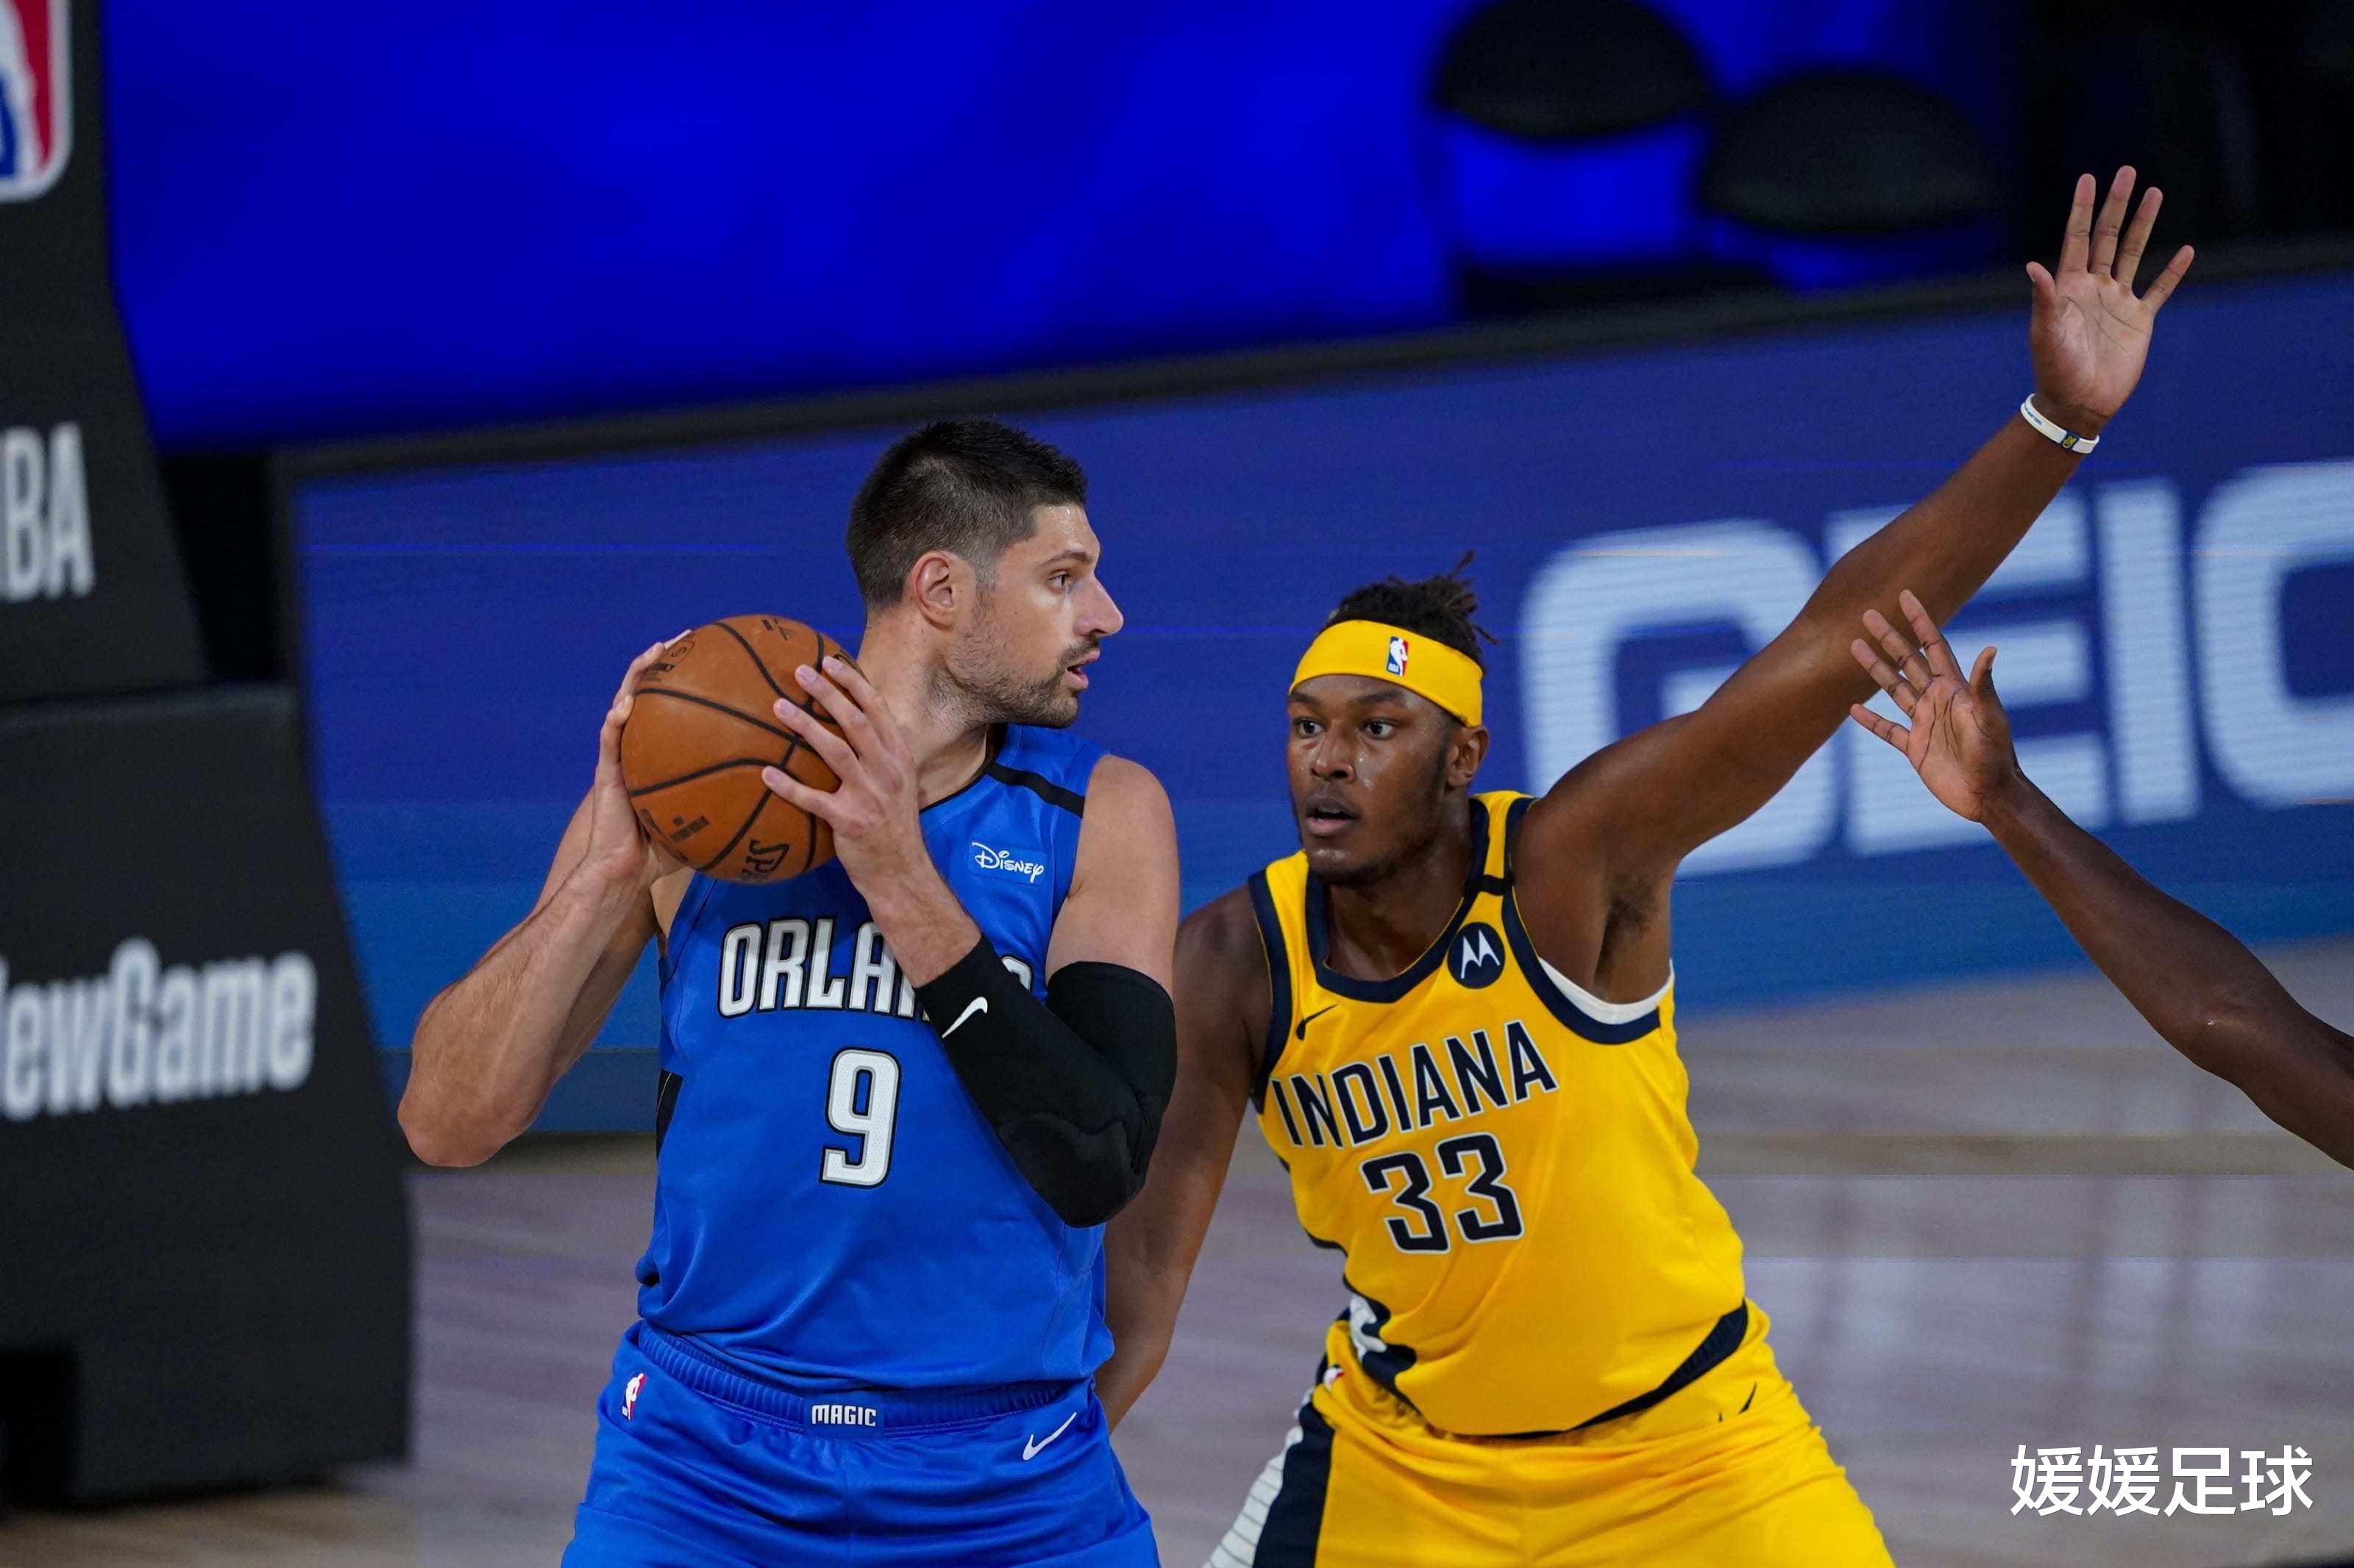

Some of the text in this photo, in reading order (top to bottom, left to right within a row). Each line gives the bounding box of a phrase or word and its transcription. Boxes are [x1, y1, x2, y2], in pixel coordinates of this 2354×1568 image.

[972, 841, 1045, 883] Disney
[0, 937, 316, 1119] ewGame
[1269, 1019, 1560, 1150] INDIANA
[819, 1047, 900, 1188] 9
[1360, 1131, 1525, 1254] 33
[811, 1404, 876, 1426] MAGIC
